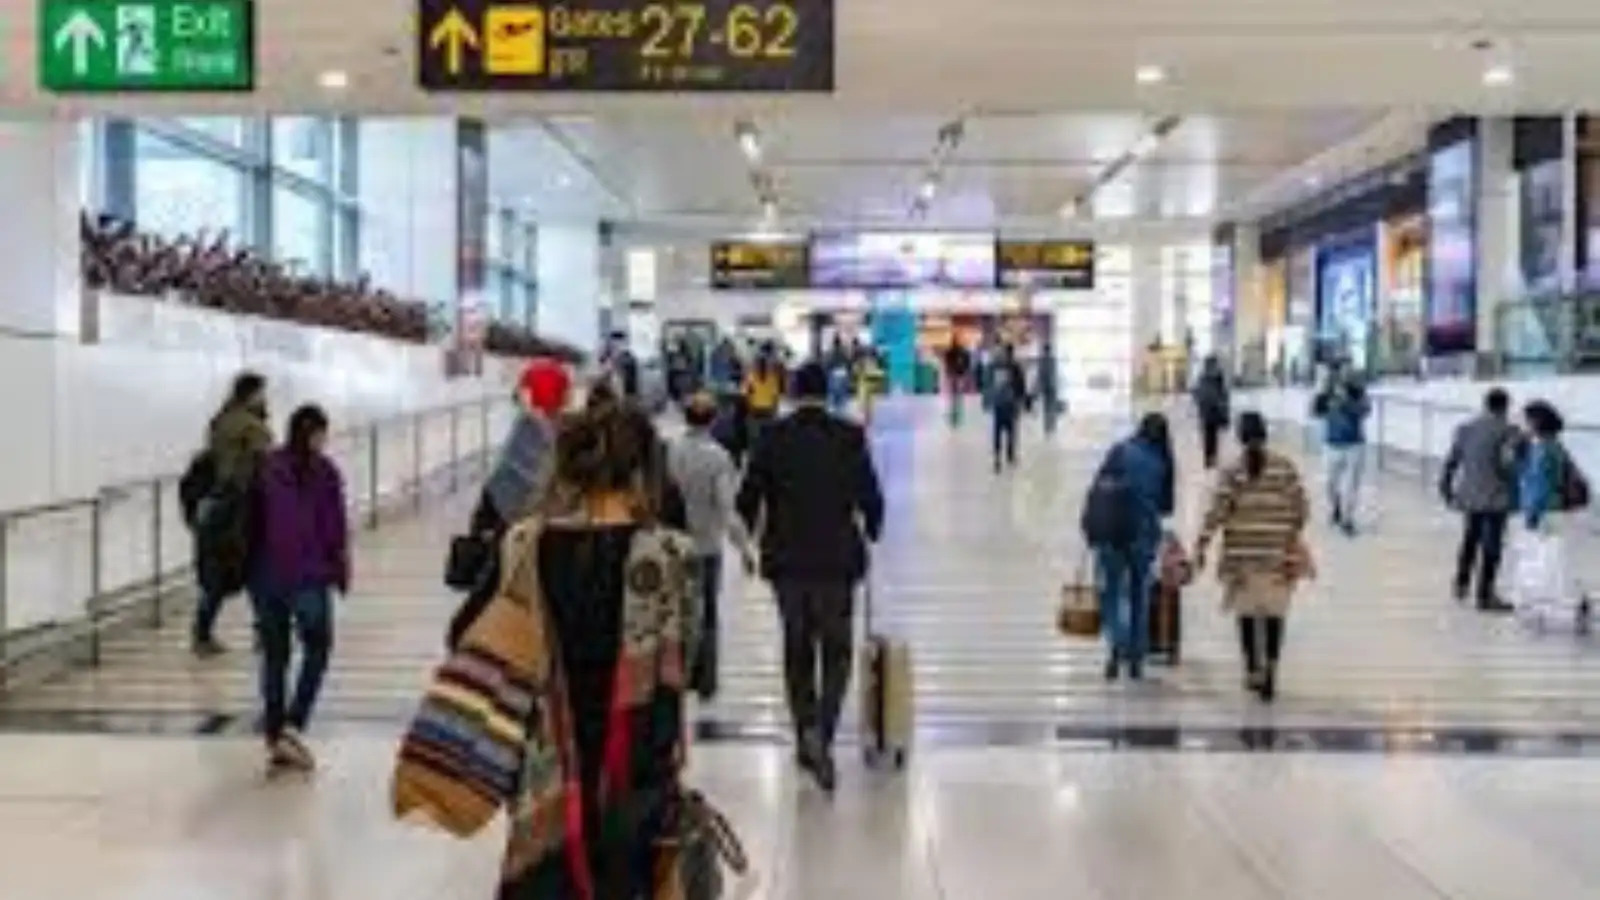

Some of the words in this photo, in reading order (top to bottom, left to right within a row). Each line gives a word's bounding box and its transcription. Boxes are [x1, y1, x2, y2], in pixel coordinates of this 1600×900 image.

[171, 5, 229, 37] Exit
[549, 7, 635, 38] Gates
[640, 4, 798, 57] 27-62
